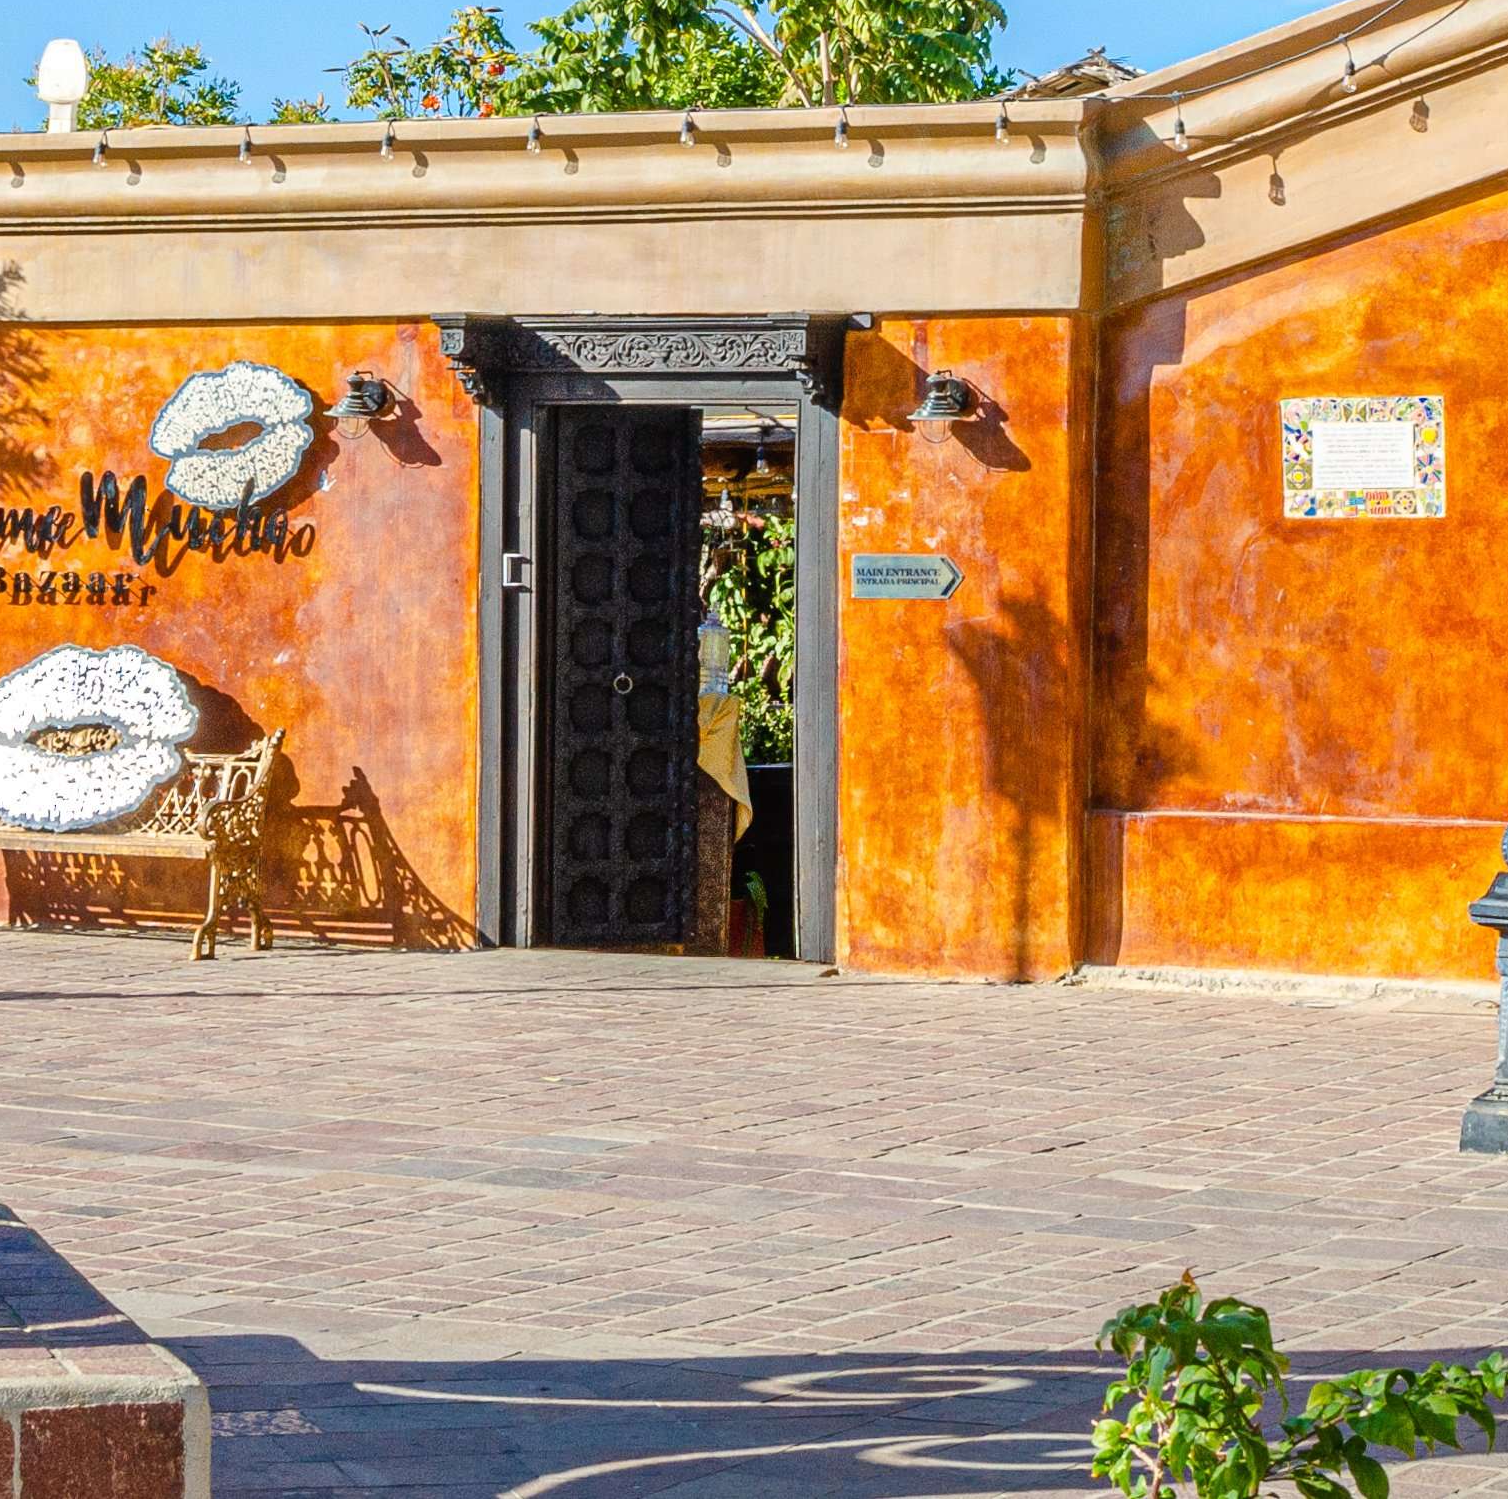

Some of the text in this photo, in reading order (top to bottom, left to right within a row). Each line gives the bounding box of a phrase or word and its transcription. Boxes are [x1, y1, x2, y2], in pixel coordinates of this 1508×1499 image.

[79, 469, 290, 566] Mucho
[856, 568, 940, 577] MAIN ENTRANCE
